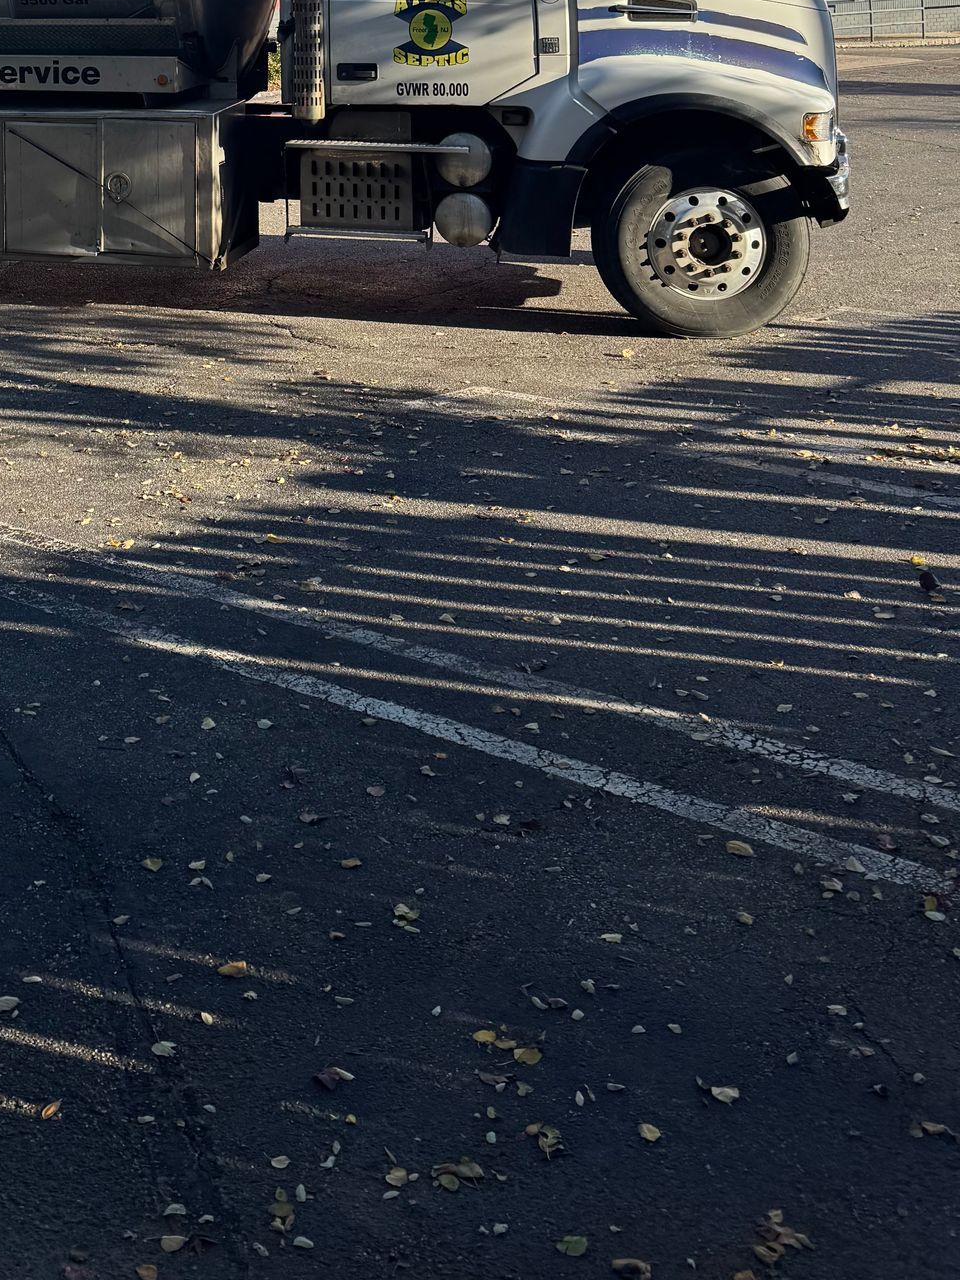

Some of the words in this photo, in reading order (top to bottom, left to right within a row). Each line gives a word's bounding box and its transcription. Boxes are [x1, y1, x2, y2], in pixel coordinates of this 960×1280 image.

[393, 47, 469, 66] SEPTIC
[396, 83, 429, 96] GVWR
[432, 83, 469, 96] 80,000
